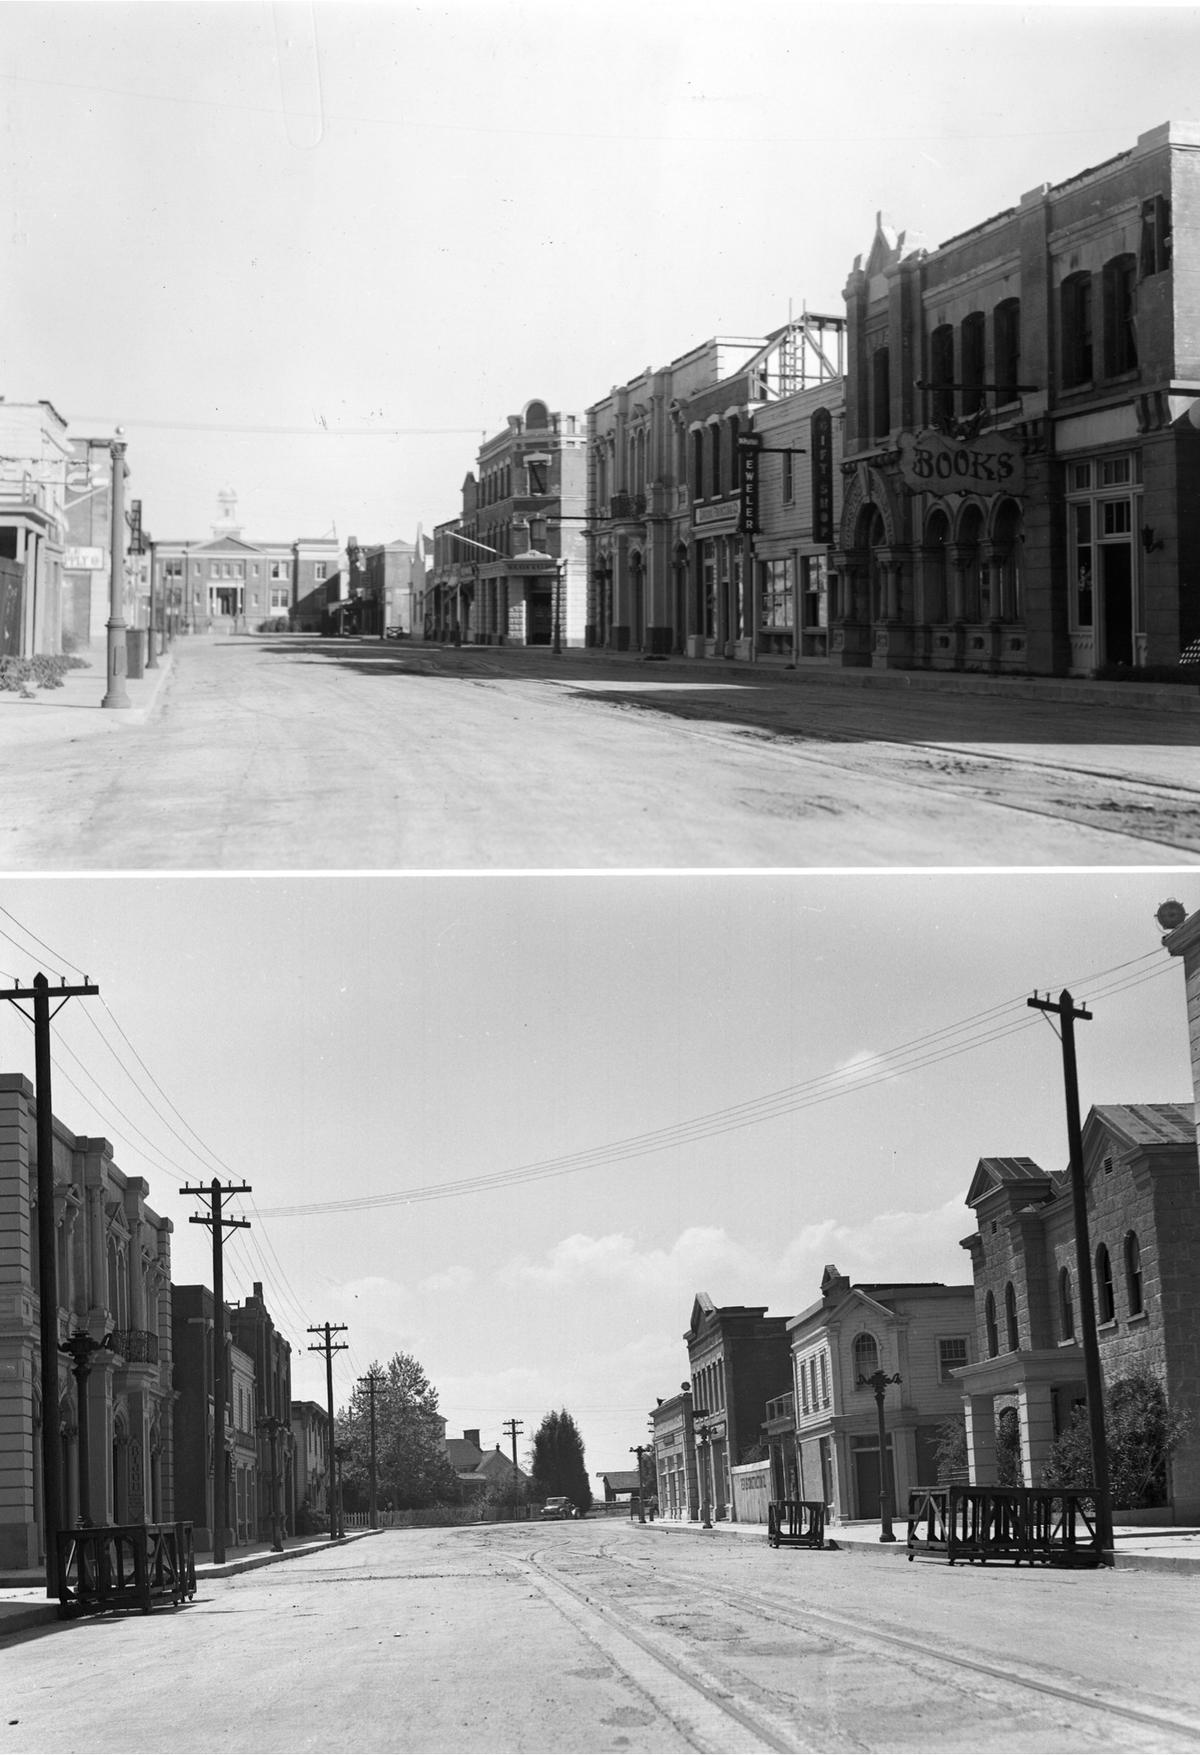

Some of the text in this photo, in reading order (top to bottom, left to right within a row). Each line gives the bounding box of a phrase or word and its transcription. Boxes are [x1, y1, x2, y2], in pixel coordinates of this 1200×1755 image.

[745, 451, 754, 528] JEWELER
[818, 419, 829, 537] GIFT SHOP
[913, 446, 1014, 482] BOOKS
